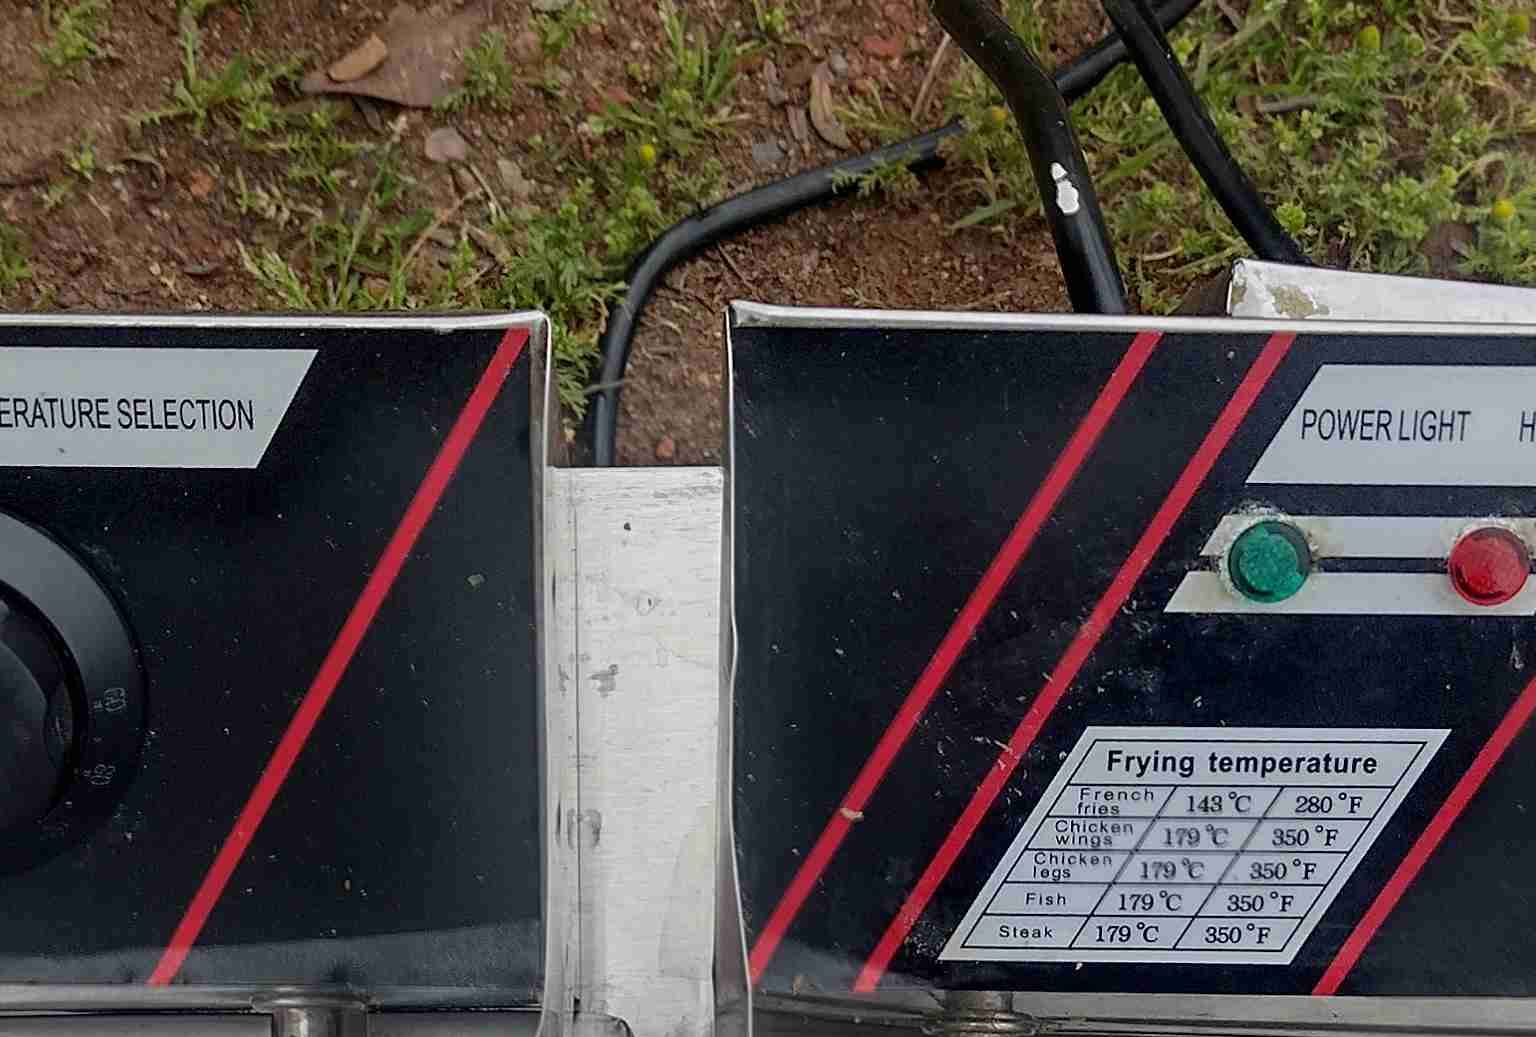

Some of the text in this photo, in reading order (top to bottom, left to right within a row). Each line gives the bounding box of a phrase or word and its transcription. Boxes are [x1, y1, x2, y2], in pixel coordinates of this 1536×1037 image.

[117, 398, 255, 431] SELECTION
[1301, 409, 1472, 442] POWER LIGHT
[1107, 750, 1378, 778] Frying temperature
[1079, 787, 1154, 801] French
[1077, 801, 1120, 815] fries
[1055, 820, 1134, 834] Chicken
[1055, 833, 1113, 848] wings
[1033, 852, 1112, 866] Chicken
[1032, 865, 1071, 881] legs
[1025, 892, 1067, 906] Fish
[999, 925, 1054, 939] Steak
